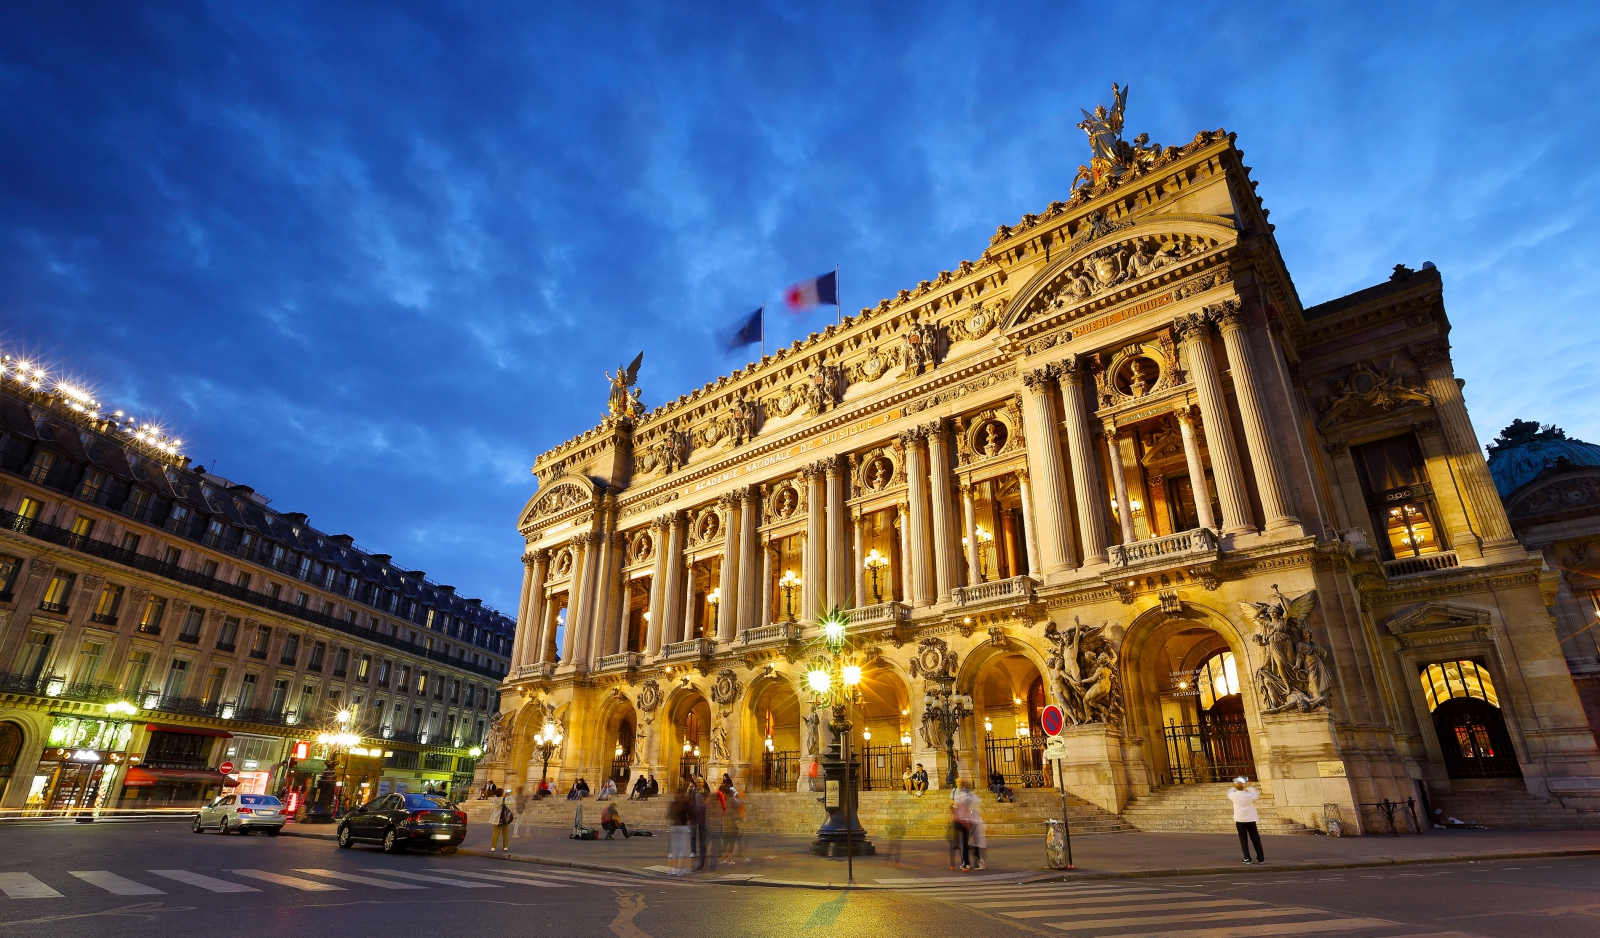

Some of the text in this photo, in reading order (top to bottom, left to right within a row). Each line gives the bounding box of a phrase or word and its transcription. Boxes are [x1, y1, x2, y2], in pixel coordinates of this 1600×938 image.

[694, 420, 873, 491] ACADEMIE NATIONALE DE MUSIQUE
[1427, 635, 1459, 644] BILLETS
